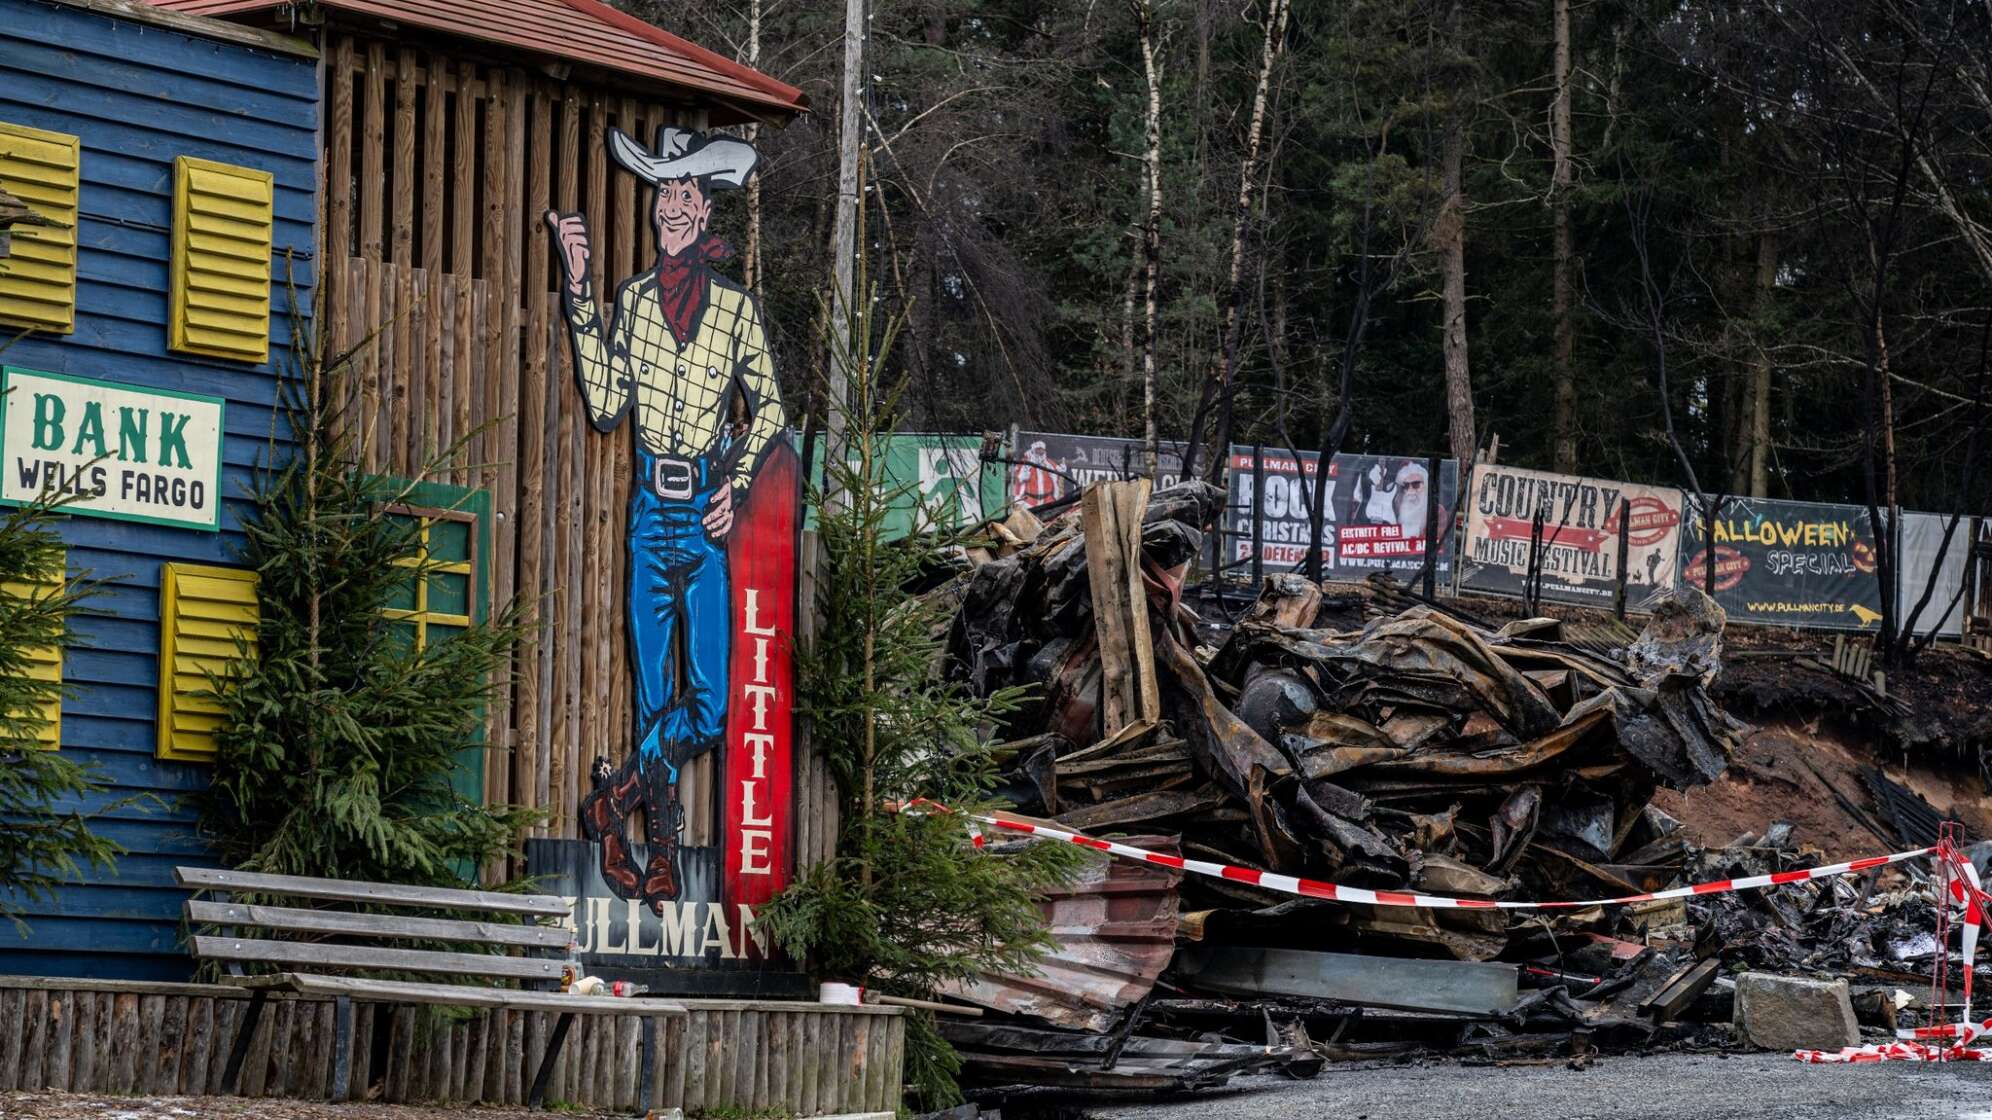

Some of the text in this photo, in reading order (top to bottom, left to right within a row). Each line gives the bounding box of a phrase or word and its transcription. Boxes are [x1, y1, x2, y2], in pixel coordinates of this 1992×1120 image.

[32, 393, 193, 470] BANK
[17, 456, 204, 510] WELLS FARGO
[1478, 472, 1620, 530] COUNTRY
[1381, 525, 1401, 537] FREI
[1342, 542, 1370, 555] AC/DC
[1374, 540, 1411, 553] REVIVAL
[1473, 536, 1527, 567] MUSIC
[1765, 549, 1857, 576] SPECIAL
[1747, 601, 1845, 613] WWW.PULLMANCITY.DE
[738, 588, 776, 875] LITTLE
